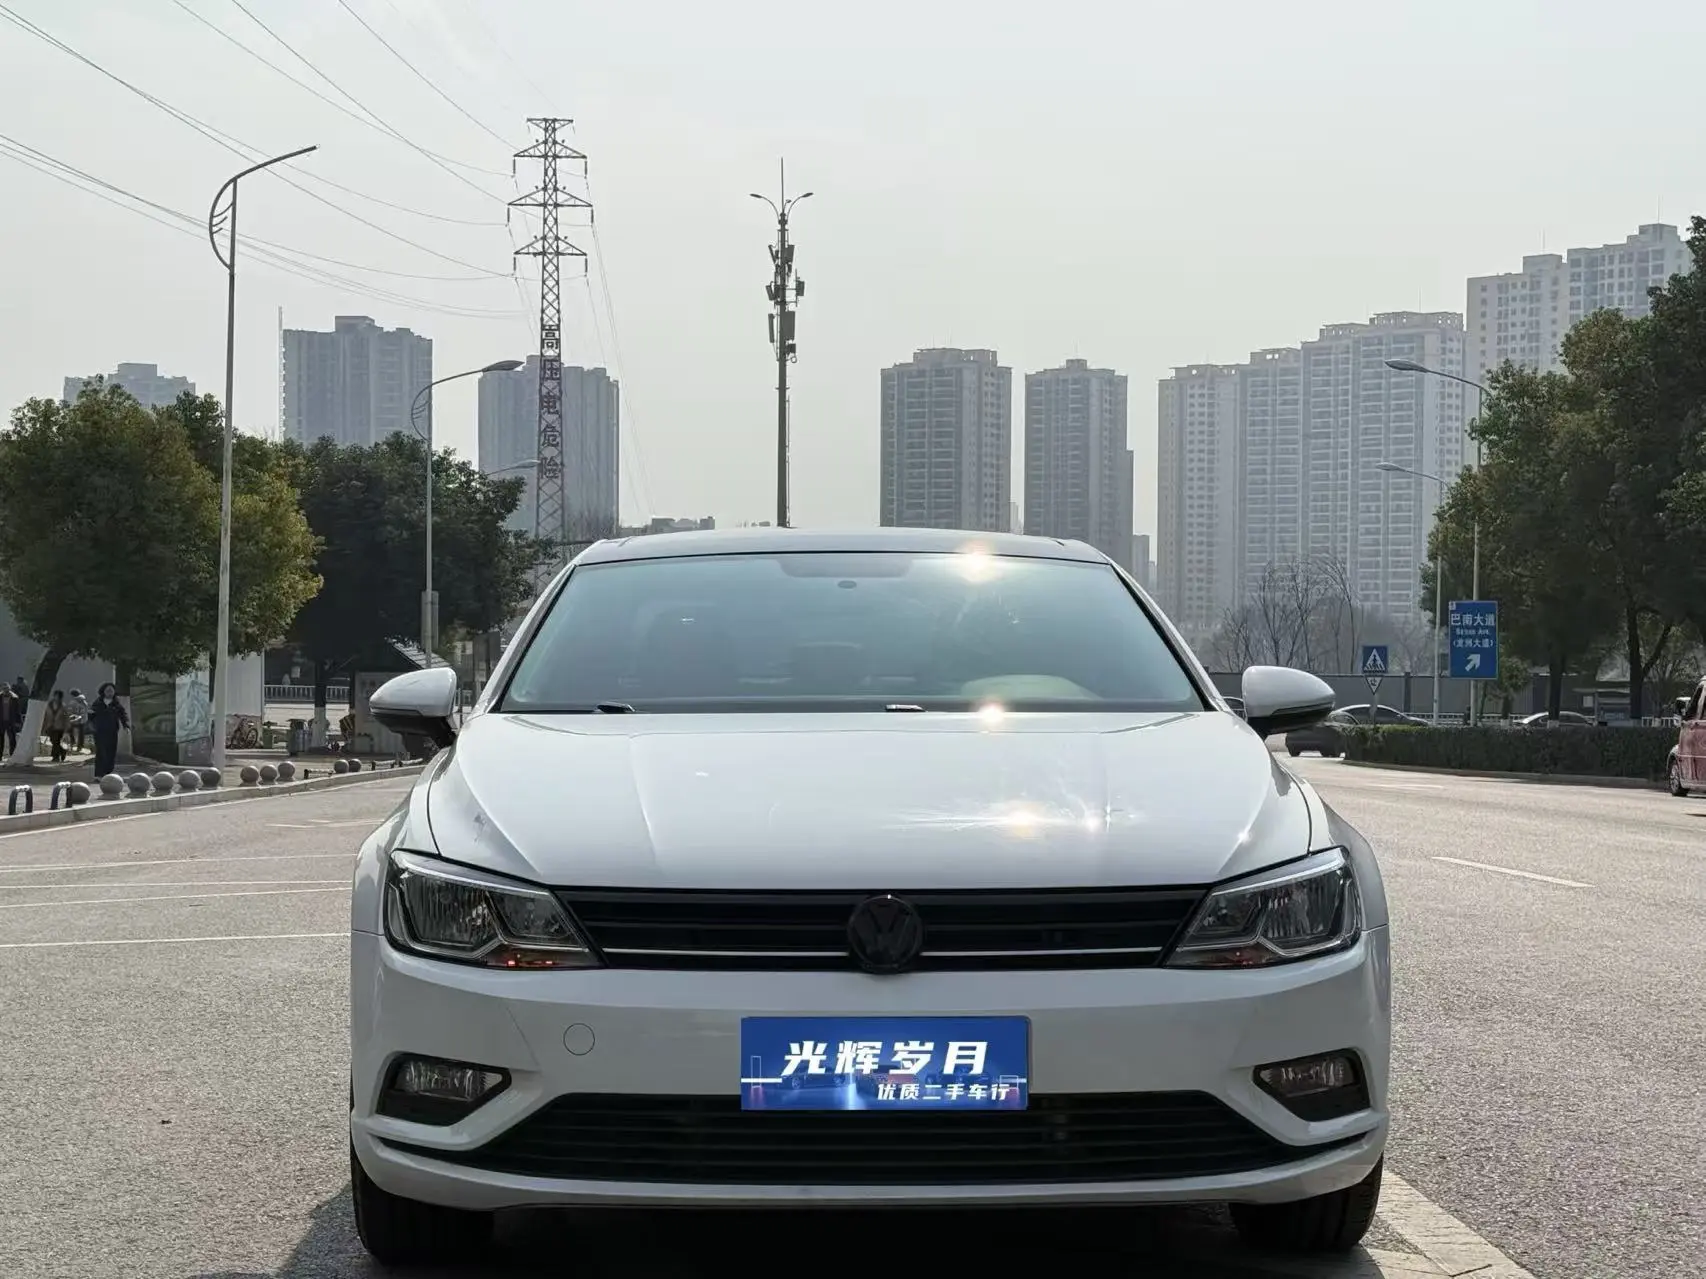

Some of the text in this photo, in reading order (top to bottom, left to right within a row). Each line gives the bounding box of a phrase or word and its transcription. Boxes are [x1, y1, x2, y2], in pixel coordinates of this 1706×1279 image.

[1451, 612, 1495, 626] 巴南大道
[781, 1040, 988, 1076] 光辉岁月
[877, 1083, 1010, 1101] 优质二手车行
